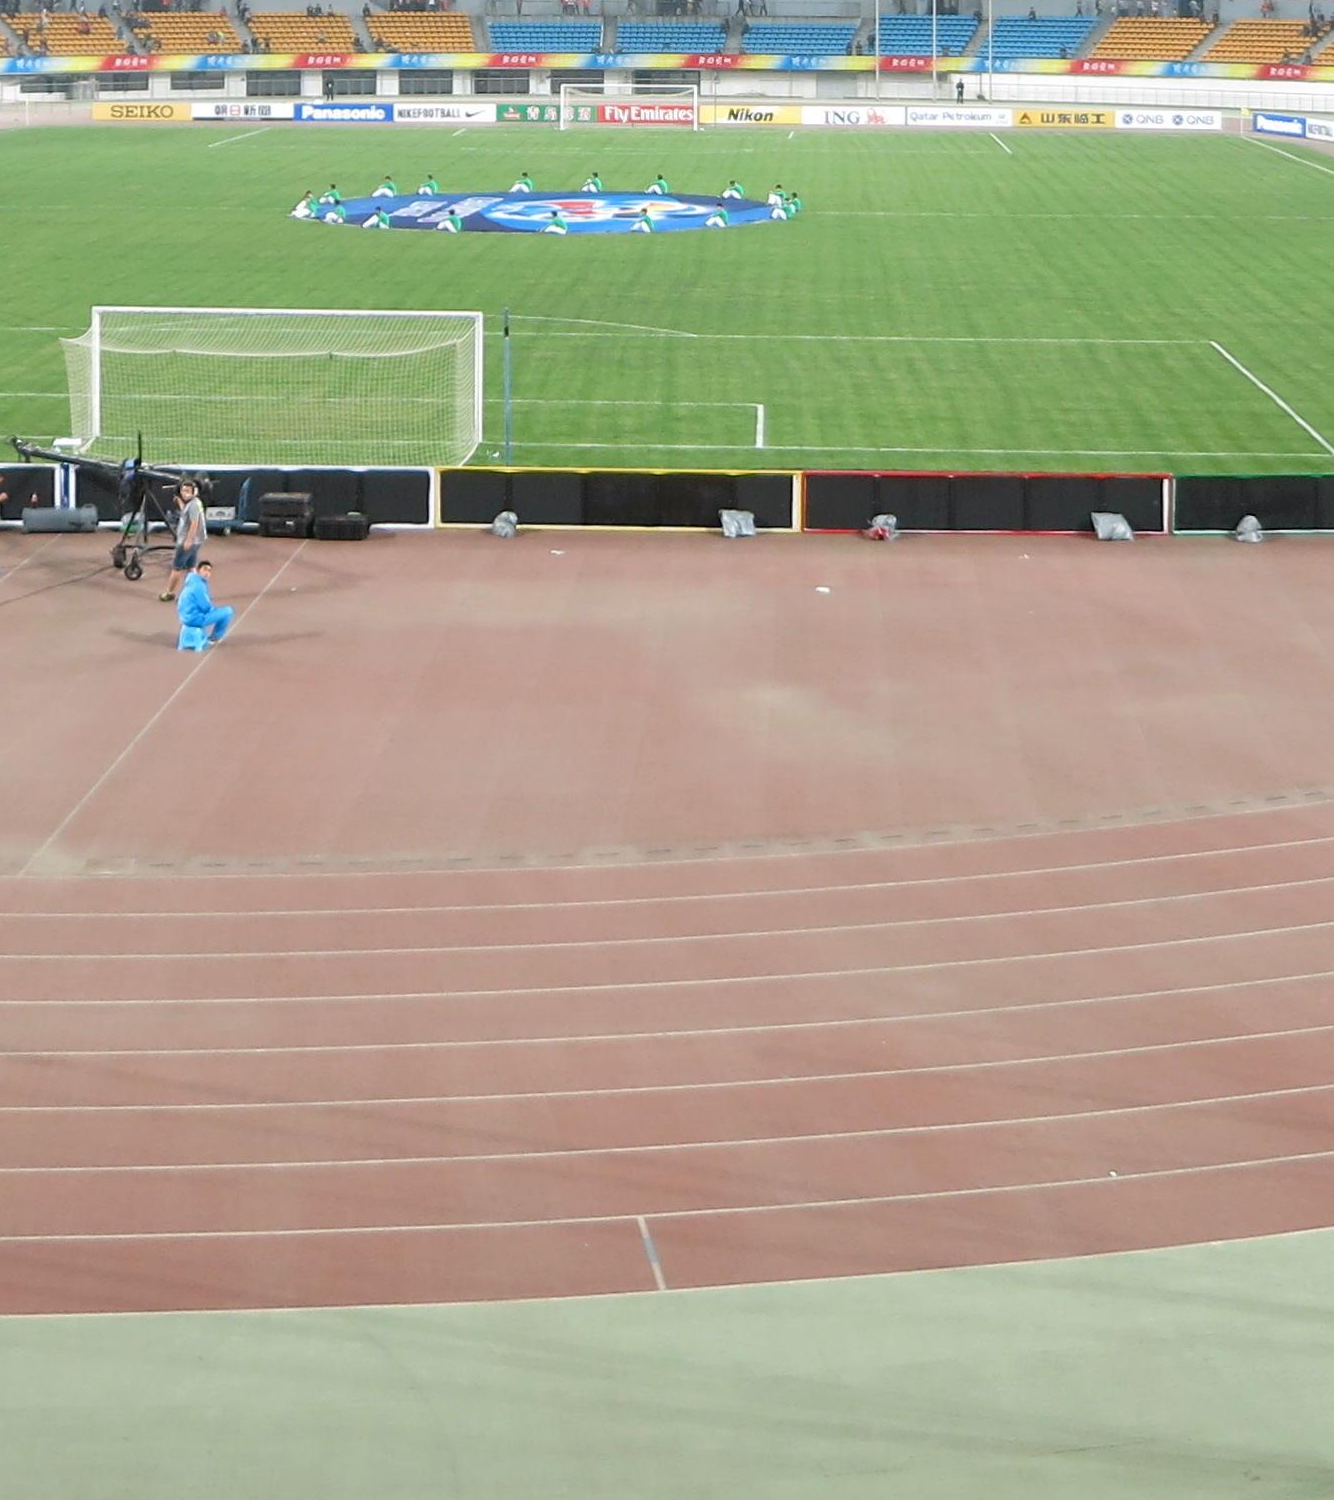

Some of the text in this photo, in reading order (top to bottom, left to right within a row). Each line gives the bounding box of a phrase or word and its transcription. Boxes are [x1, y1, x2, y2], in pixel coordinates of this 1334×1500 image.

[110, 104, 174, 119] SEIKO
[301, 104, 386, 121] Panasonic
[604, 105, 693, 124] Fly Emirates
[726, 108, 774, 122] Nikon
[824, 110, 861, 125] ING
[909, 111, 938, 122] Qatar
